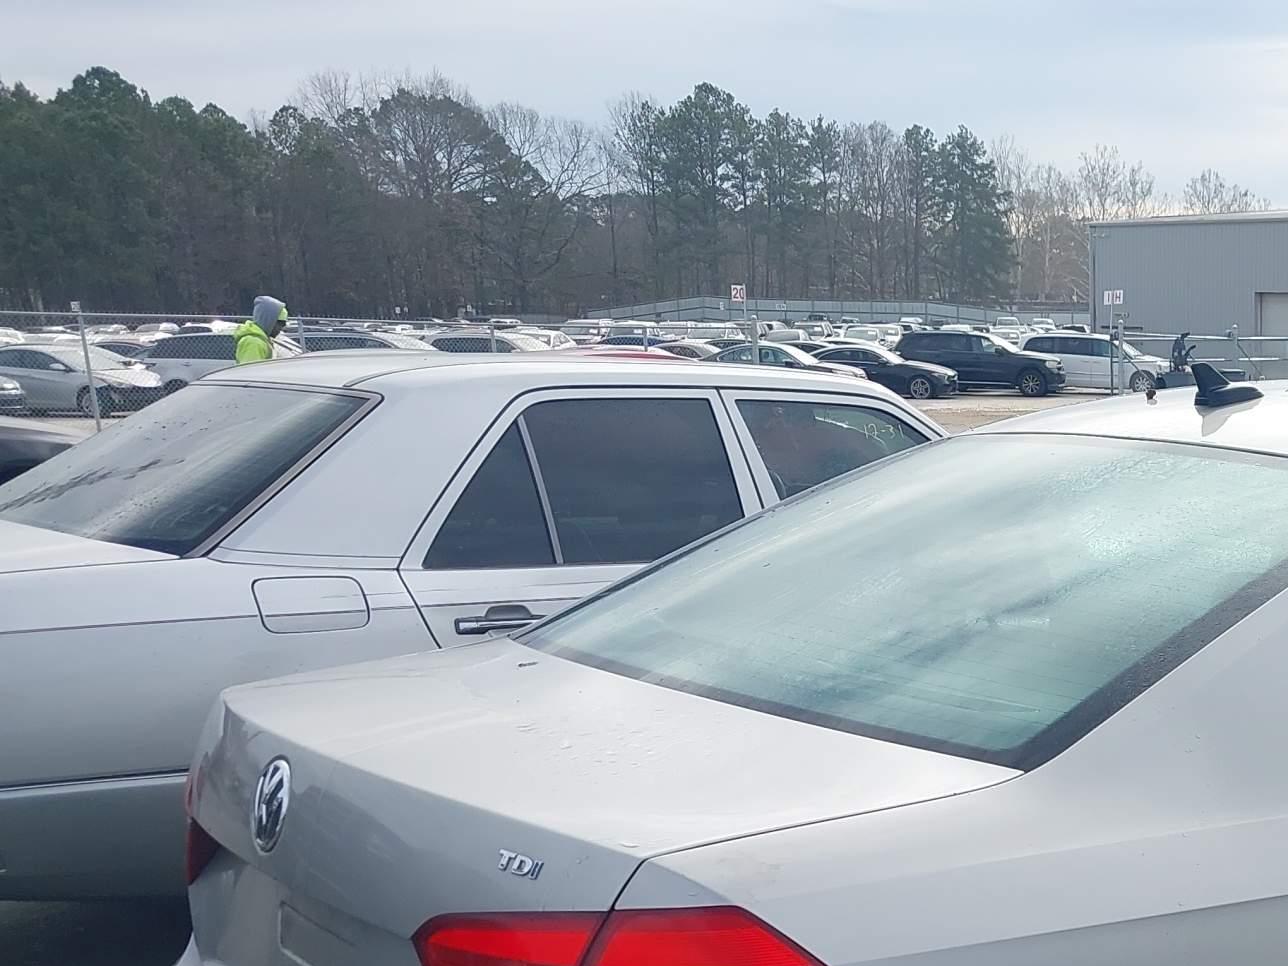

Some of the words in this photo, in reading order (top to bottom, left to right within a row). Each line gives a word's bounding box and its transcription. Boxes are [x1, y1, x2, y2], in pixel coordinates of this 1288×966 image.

[732, 287, 745, 300] 20
[1115, 291, 1121, 303] H
[498, 848, 545, 881] TDI
